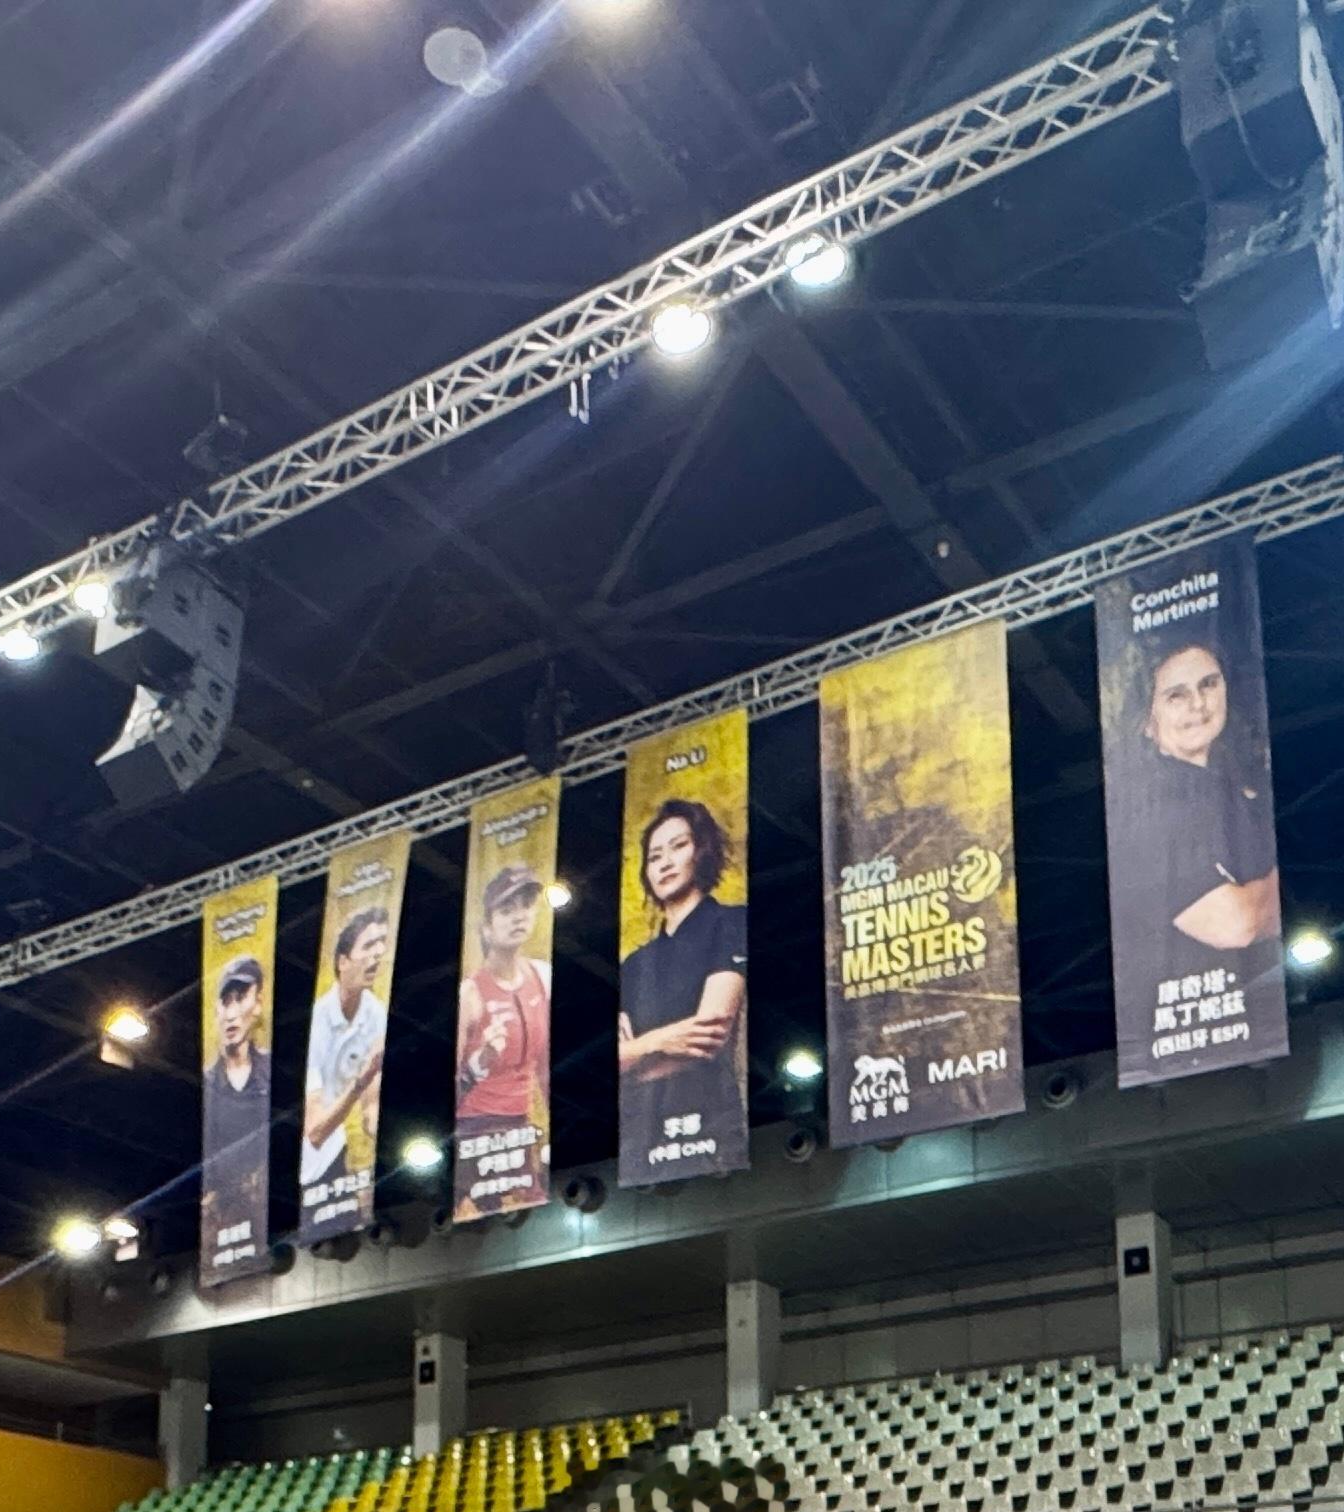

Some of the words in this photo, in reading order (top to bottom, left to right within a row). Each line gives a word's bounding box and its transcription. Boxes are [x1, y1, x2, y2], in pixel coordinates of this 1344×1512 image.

[1131, 572, 1218, 613] Conchita
[841, 854, 898, 892] 2025
[841, 887, 885, 914] MGM
[886, 867, 950, 902] MACAU
[841, 890, 950, 948] TENNIS
[842, 916, 987, 985] MASTERS
[1211, 1022, 1250, 1044] ESP)
[928, 1046, 1008, 1085] MARI
[849, 1076, 911, 1106] MGM
